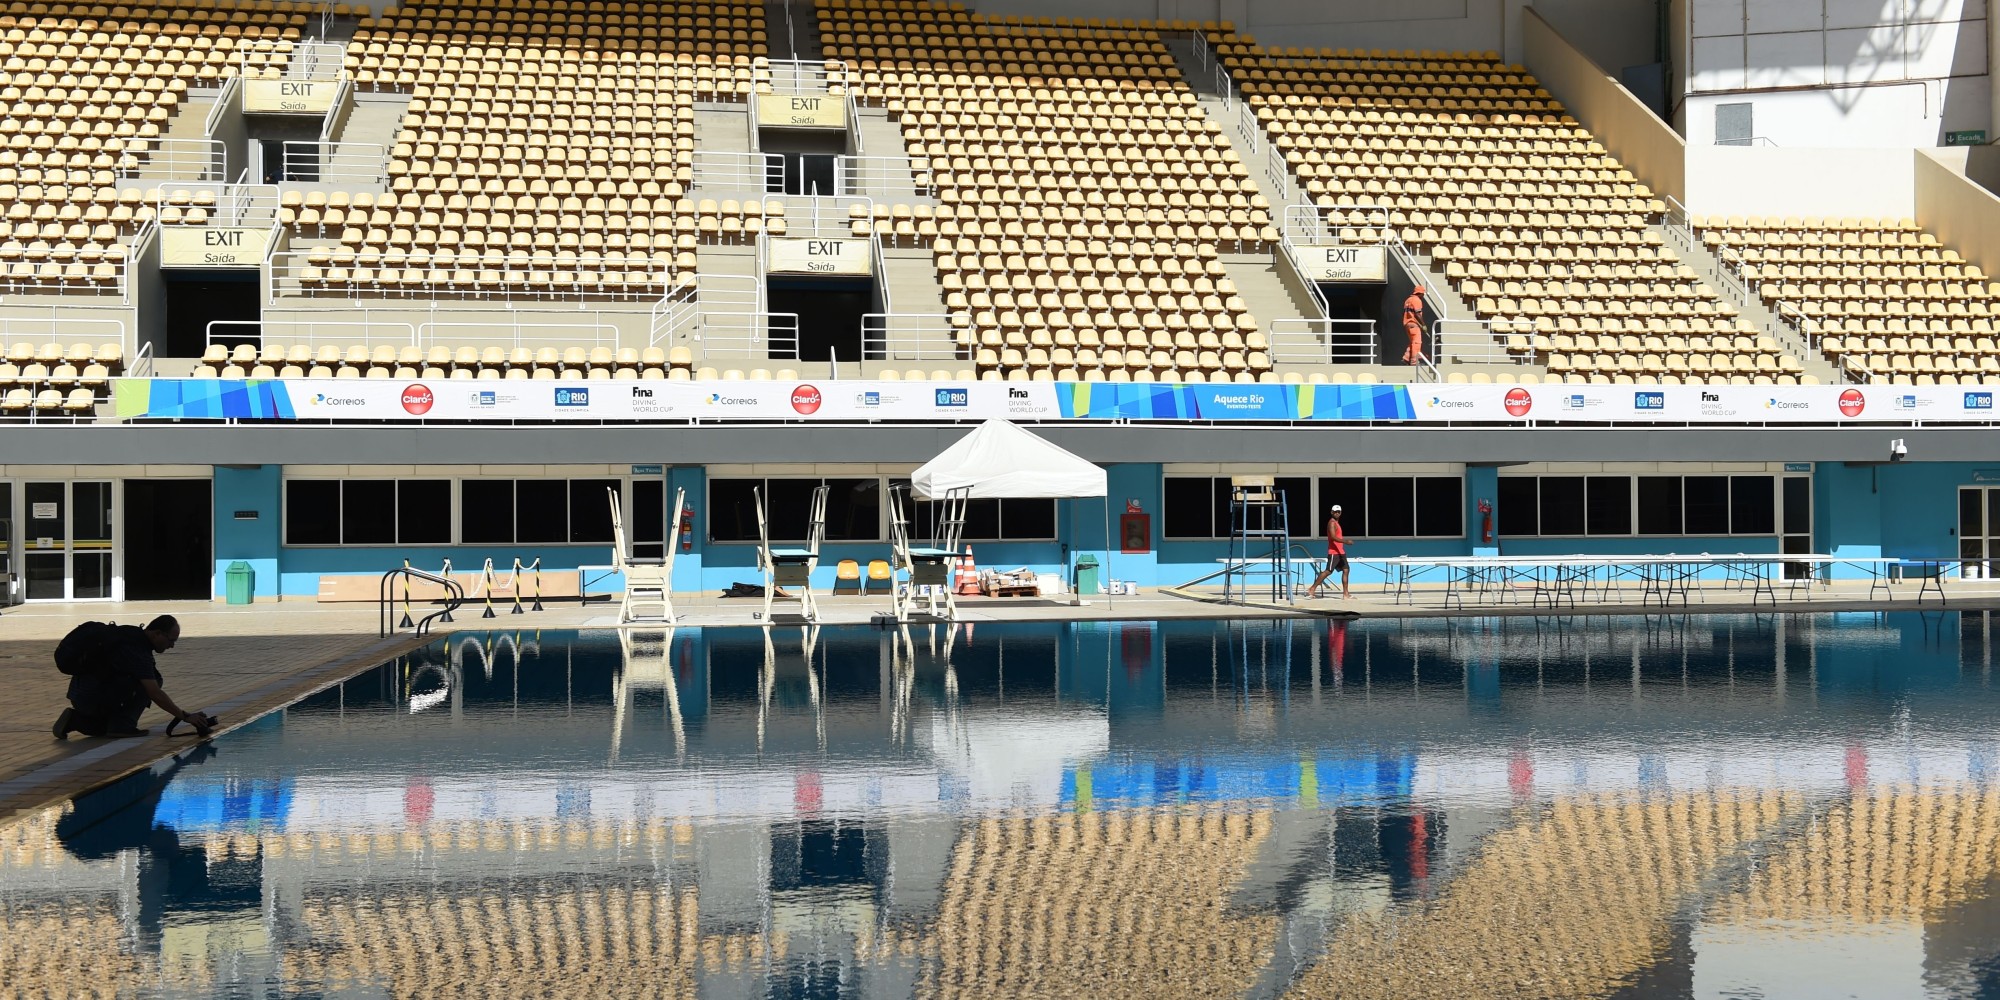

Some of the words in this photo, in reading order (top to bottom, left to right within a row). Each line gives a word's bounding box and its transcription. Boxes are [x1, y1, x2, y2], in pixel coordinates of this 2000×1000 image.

[281, 83, 314, 96] EXIT
[791, 98, 821, 111] EXIT
[205, 231, 244, 246] EXIT
[808, 241, 843, 256] EXIT
[204, 253, 236, 263] Saída
[1326, 248, 1359, 263] EXIT
[807, 261, 836, 272] Saída
[1325, 269, 1352, 278] Saída
[571, 392, 587, 401] RIO
[632, 386, 653, 398] Fina
[1009, 387, 1028, 398] Fina
[1701, 391, 1719, 402] Fina
[326, 397, 366, 406] Correios
[402, 395, 429, 404] Claro
[721, 397, 758, 405] Correios
[792, 395, 817, 404] Claro
[951, 393, 966, 402] RIO
[1213, 394, 1248, 406] Aquece
[1249, 394, 1265, 404] Rio
[1505, 398, 1527, 406] Claro
[1649, 396, 1663, 405] RIO
[1977, 396, 1991, 405] RIO
[1440, 400, 1474, 408] Correios
[1777, 401, 1809, 409] Correios
[1839, 399, 1861, 407] Claro
